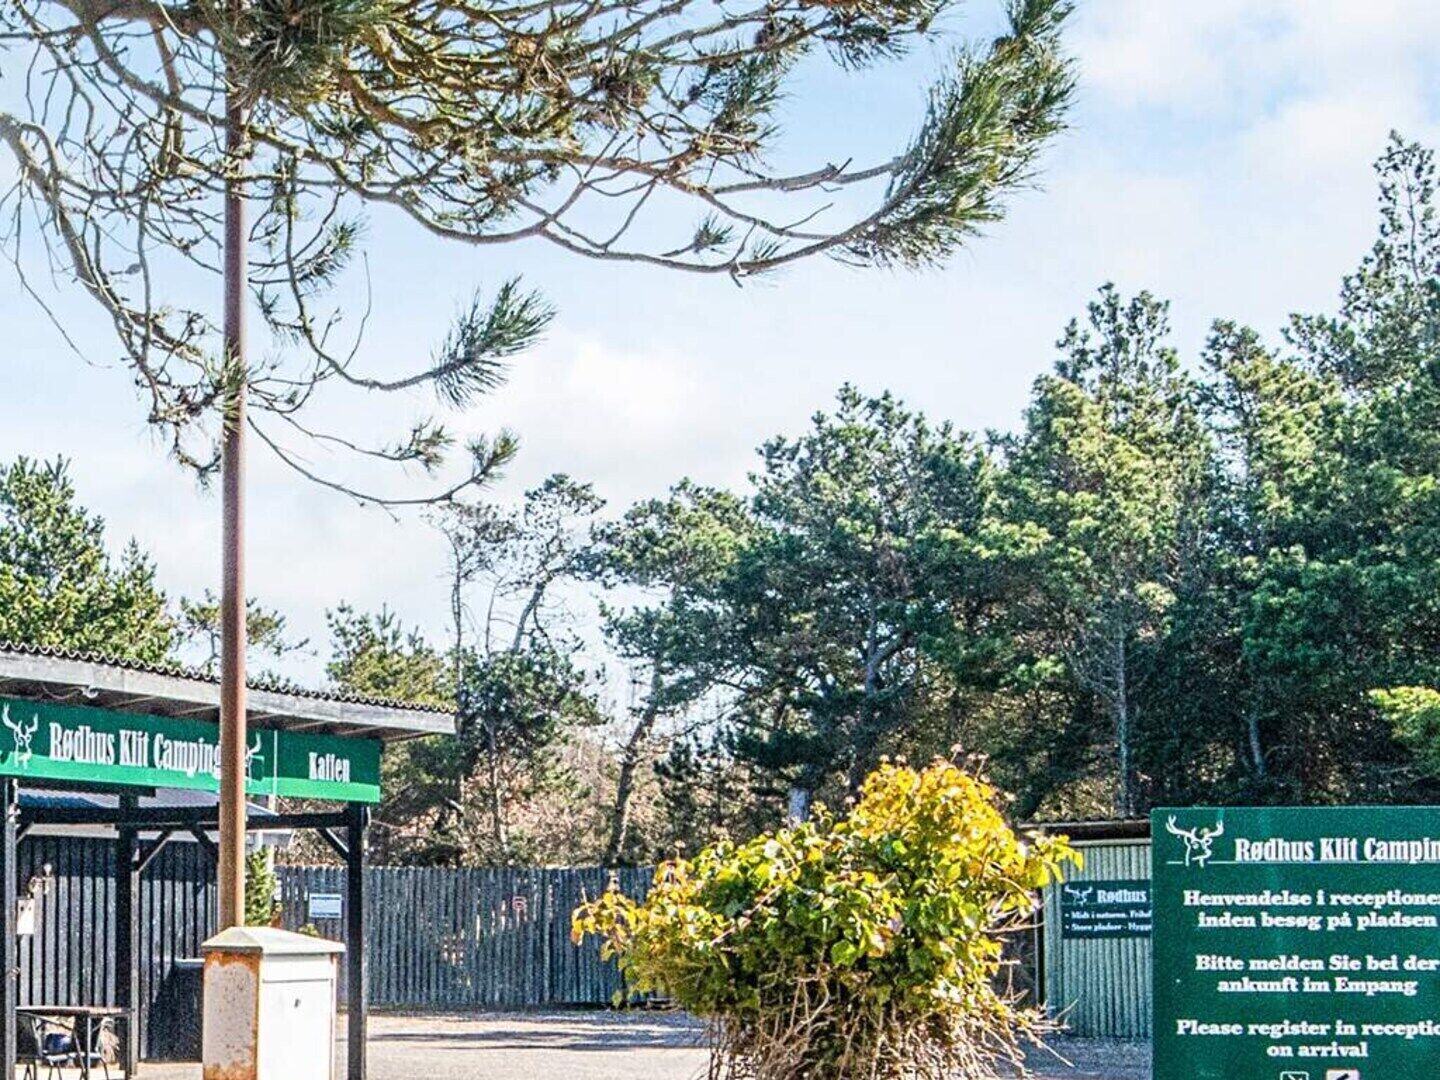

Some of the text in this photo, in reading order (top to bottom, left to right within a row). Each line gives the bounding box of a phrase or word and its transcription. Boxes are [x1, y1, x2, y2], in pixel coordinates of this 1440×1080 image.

[49, 722, 222, 780] Rødhus Klit Camping
[1235, 837, 1314, 862] Rødhus
[1320, 837, 1357, 861] Klit
[1096, 889, 1147, 904] Rødhus
[1183, 889, 1440, 909] Henvendelse i receptione
[1198, 911, 1437, 931] inden besøg på pladsen
[1195, 955, 1440, 971] Bitte melden Sie bei der
[1217, 977, 1418, 996] ankunft im Empang
[1176, 1020, 1243, 1035] Please
[1248, 1020, 1331, 1038] register
[1336, 1020, 1356, 1035] in
[1267, 1041, 1368, 1057] on arrival
